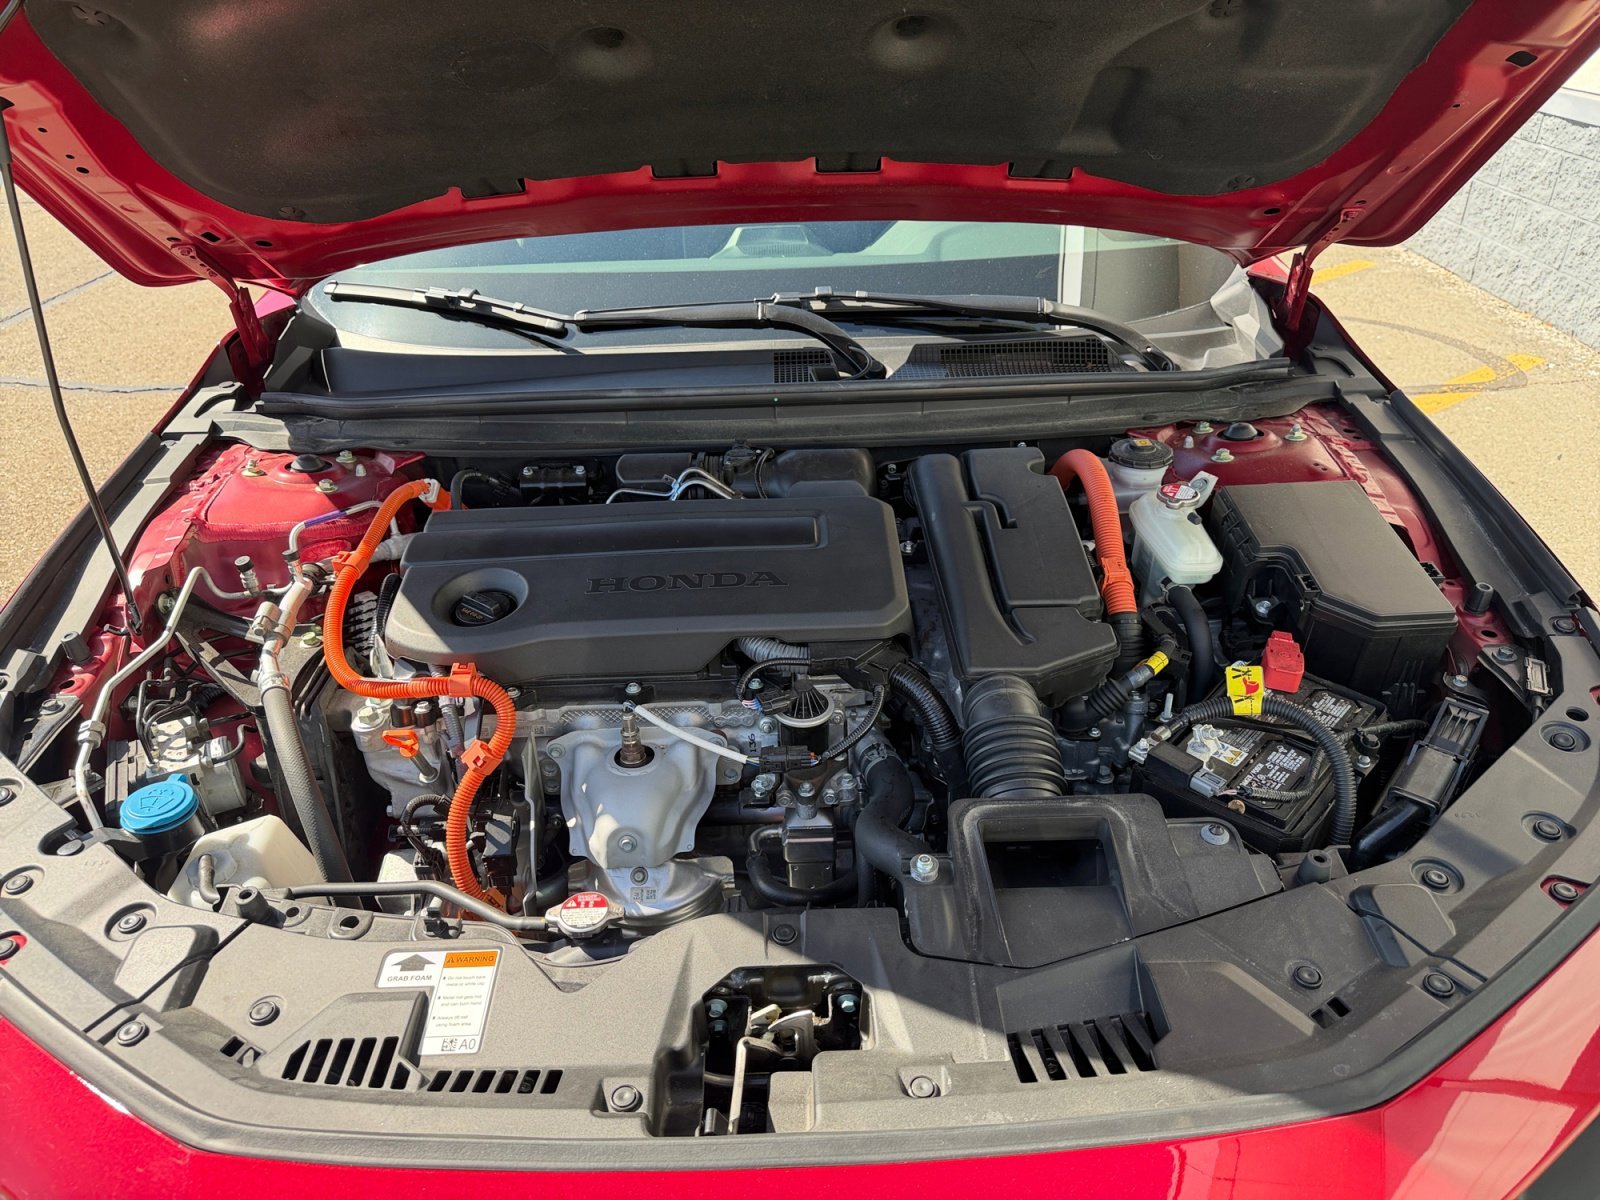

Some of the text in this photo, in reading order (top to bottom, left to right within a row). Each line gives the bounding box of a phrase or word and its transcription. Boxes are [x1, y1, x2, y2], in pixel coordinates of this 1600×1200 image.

[584, 571, 789, 594] HONDA
[456, 955, 494, 963] WARNING
[458, 1038, 477, 1051] A0
